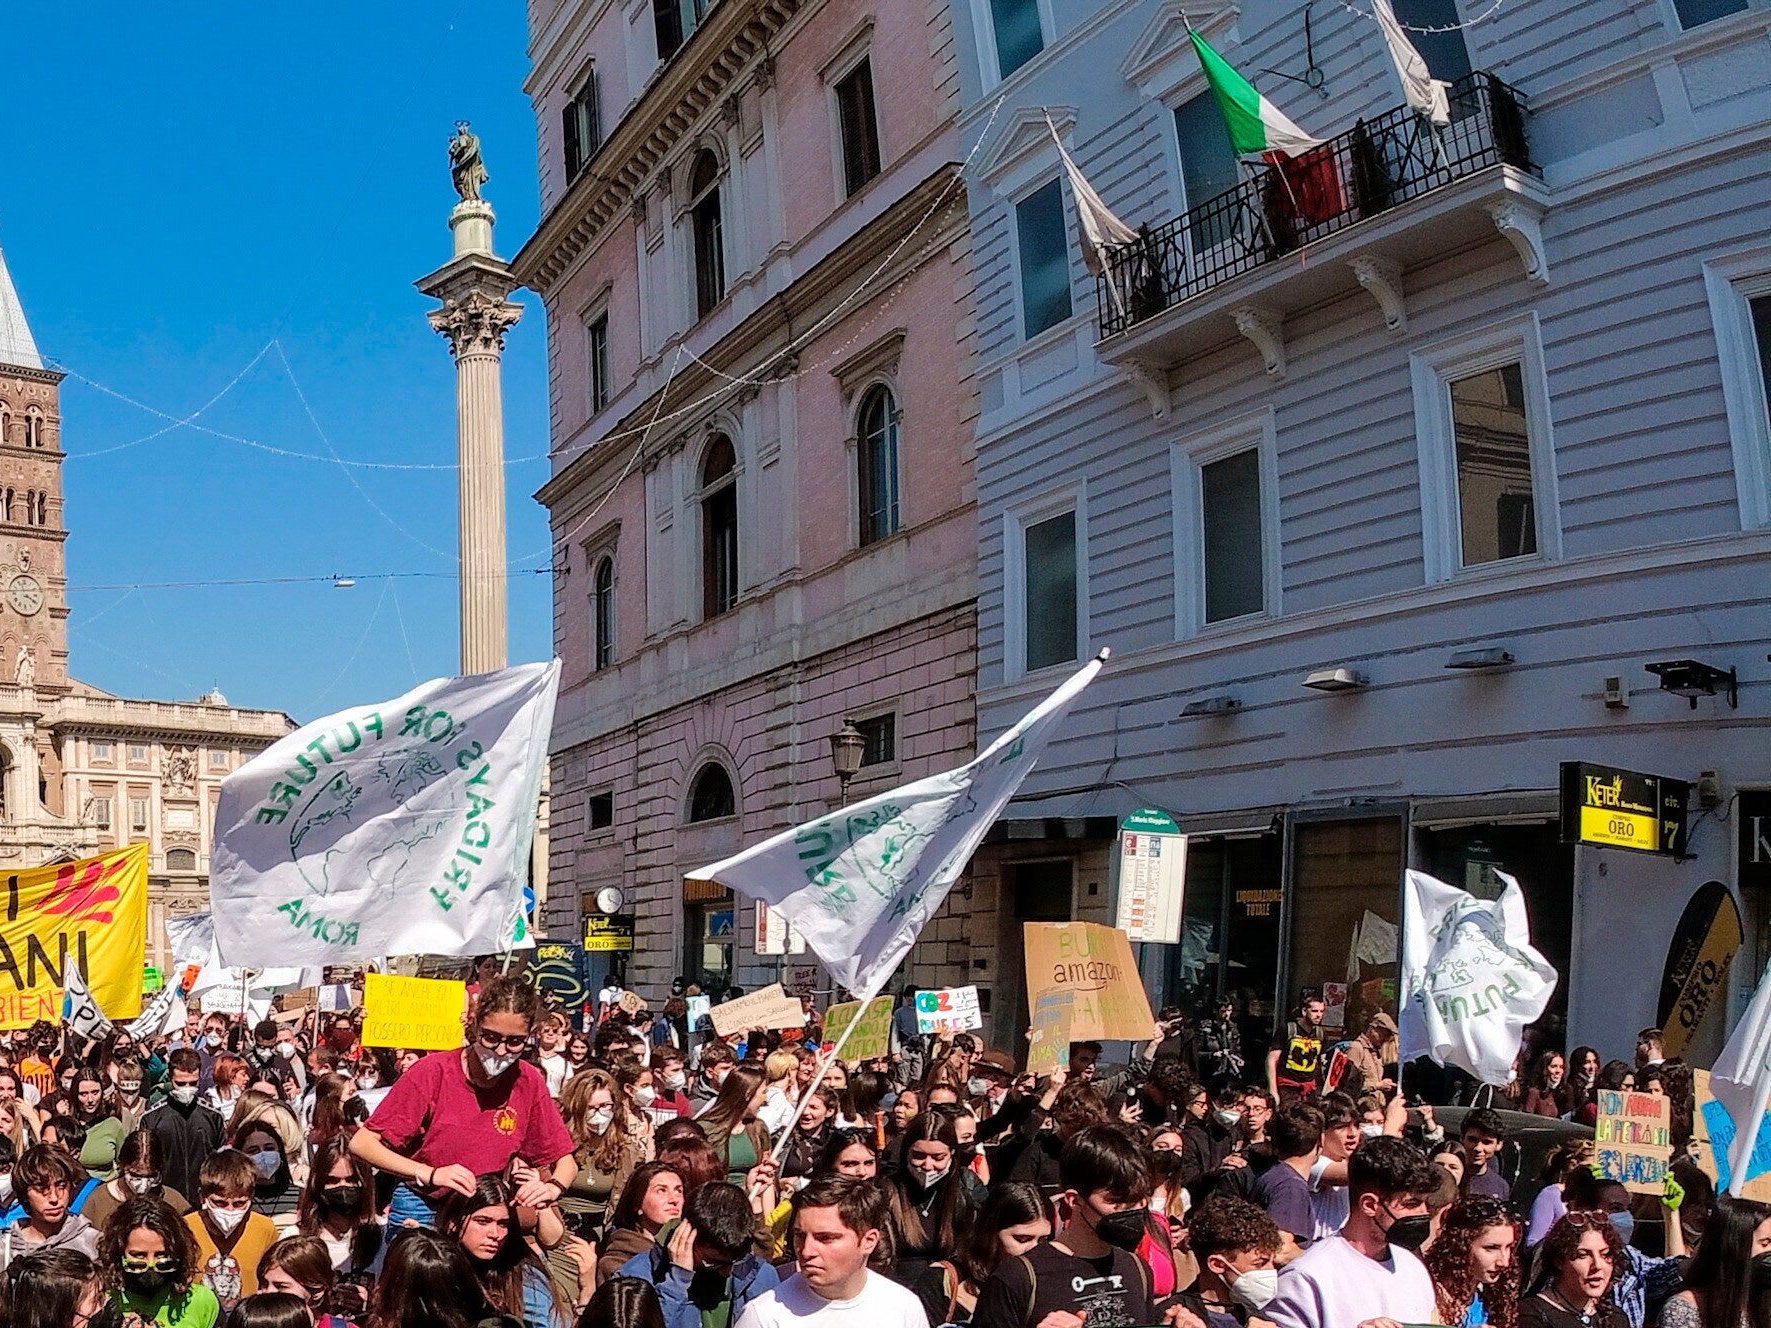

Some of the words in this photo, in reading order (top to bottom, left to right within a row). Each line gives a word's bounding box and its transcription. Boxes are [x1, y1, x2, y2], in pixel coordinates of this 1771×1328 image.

[1585, 775, 1620, 807] KETER
[1608, 819, 1635, 837] ORO
[1664, 820, 1679, 849] 7
[587, 940, 610, 949] ORO
[1054, 960, 1122, 984] amazon
[1680, 959, 1716, 1029] ORO
